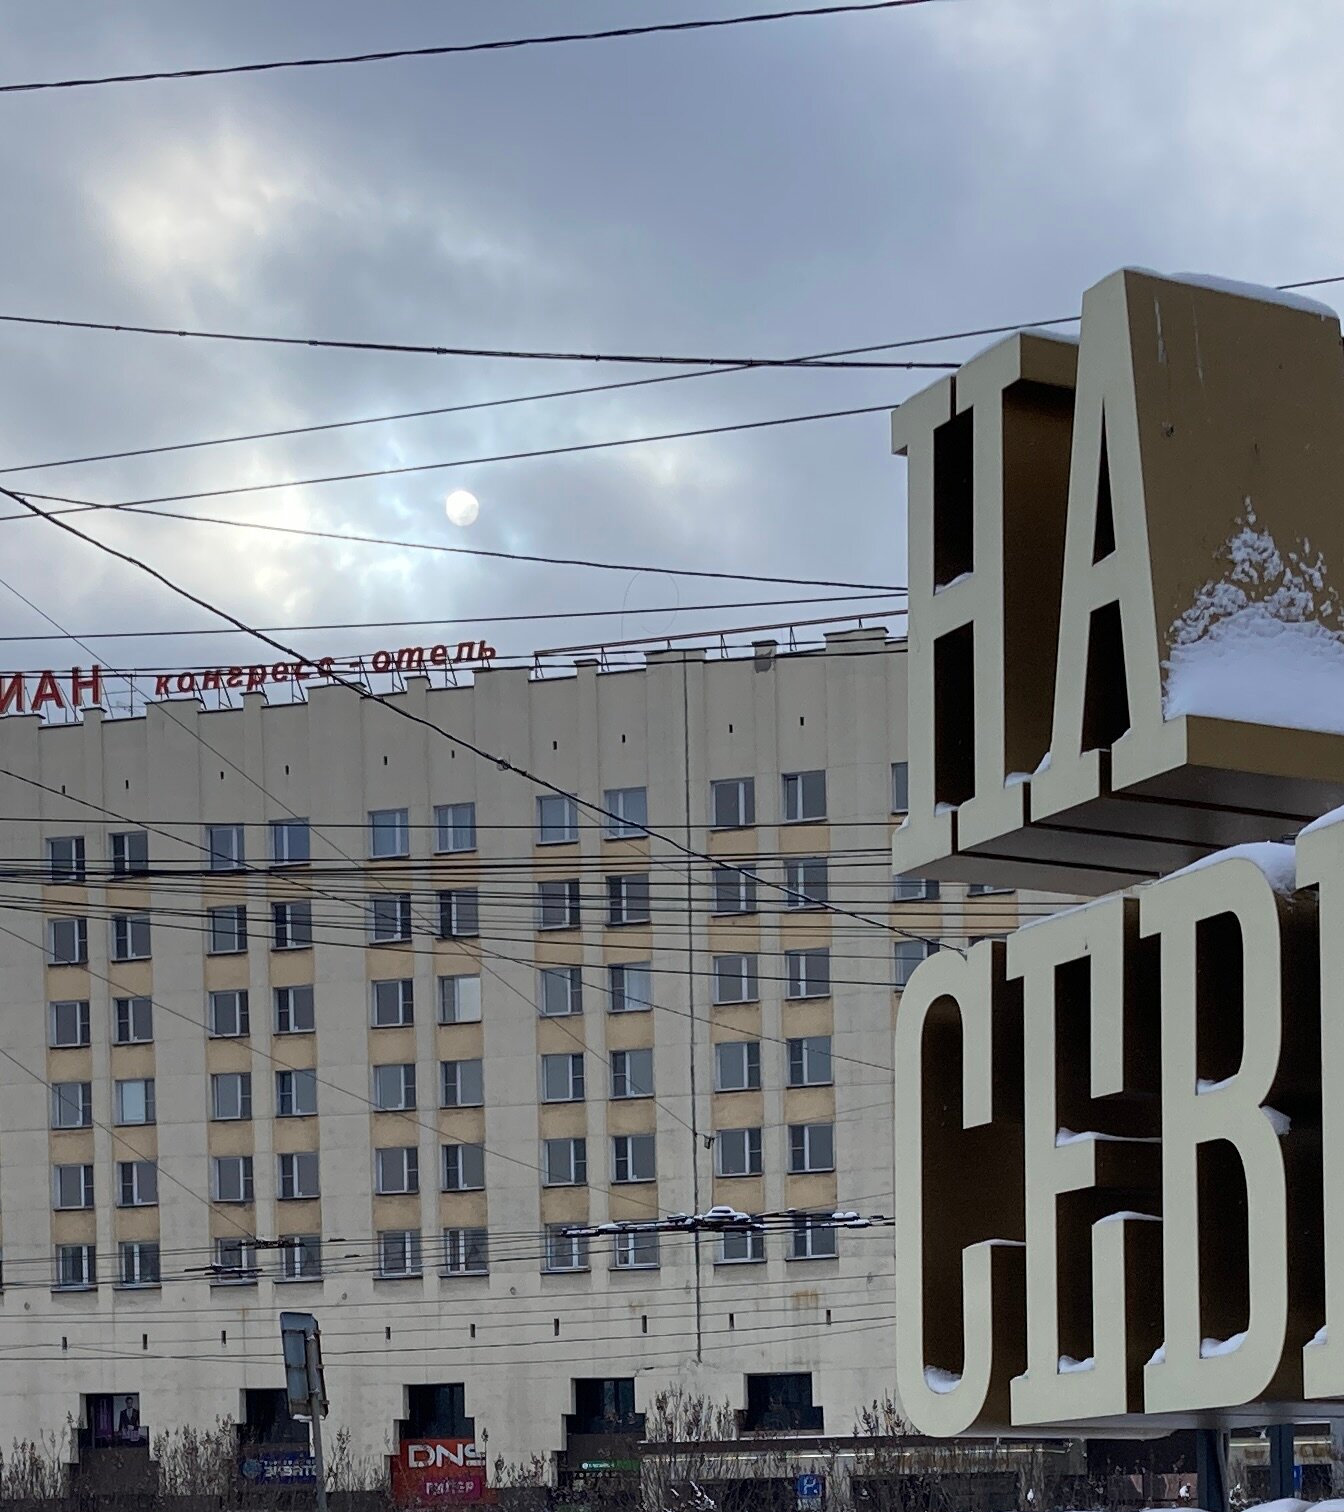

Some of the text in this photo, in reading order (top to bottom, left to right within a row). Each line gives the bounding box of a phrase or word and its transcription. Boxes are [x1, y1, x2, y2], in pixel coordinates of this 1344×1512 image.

[891, 266, 1188, 875] НА
[154, 657, 335, 696] конгресс
[372, 640, 497, 673] отель
[408, 1443, 486, 1469] DNS
